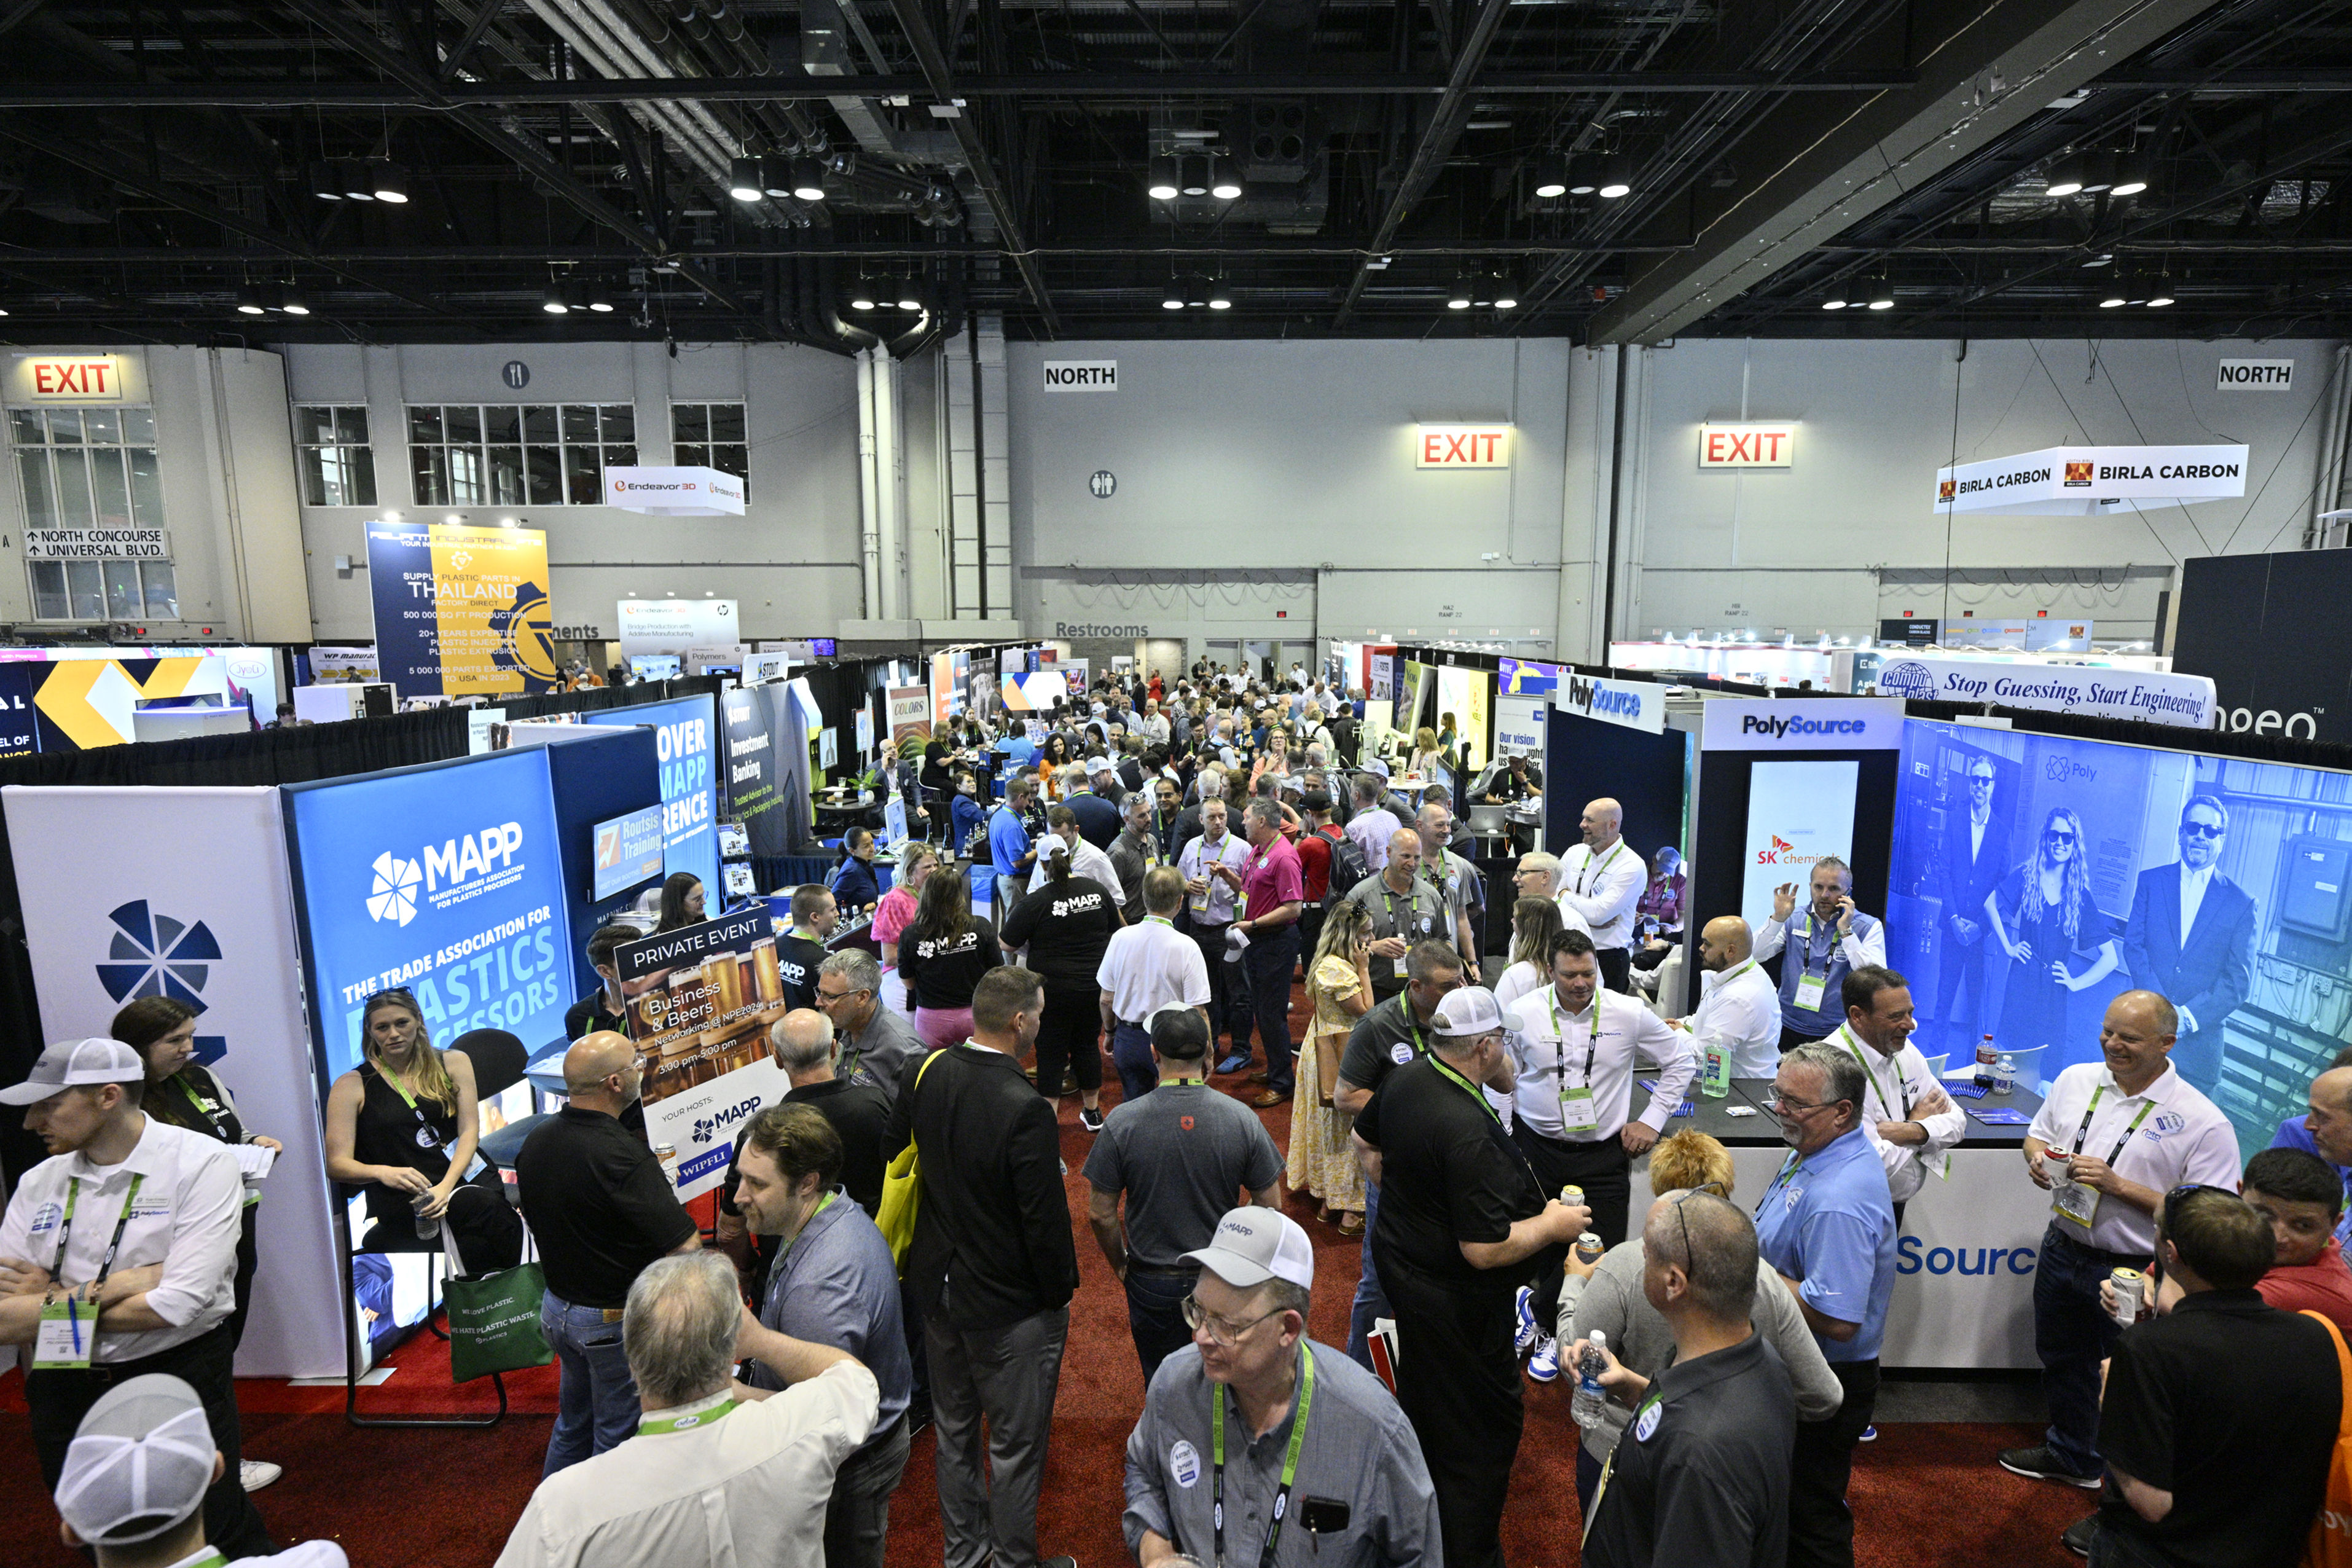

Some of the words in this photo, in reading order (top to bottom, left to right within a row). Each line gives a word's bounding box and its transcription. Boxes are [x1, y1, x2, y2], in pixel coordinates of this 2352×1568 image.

[35, 364, 109, 393] EXIT
[1046, 367, 1115, 384] NORTH
[2220, 366, 2291, 383] NORTH
[1424, 434, 1502, 462] EXIT
[1707, 433, 1786, 461] EXIT
[1959, 477, 1993, 493] BIRLA
[1997, 468, 2050, 487] CARBON
[2100, 466, 2153, 479] BIRLA
[2160, 465, 2238, 479] CARBON
[715, 486, 735, 498] Endeavor
[41, 530, 83, 542] NORTH
[88, 530, 161, 542] CONCOURSE
[436, 535, 511, 544] INDUSTRIAL
[47, 545, 120, 556] UNIVERSAL
[127, 545, 163, 556] BLVD.
[407, 582, 517, 598] THAILAND
[1056, 622, 1148, 637] Restrooms
[763, 662, 778, 676] STOUT
[1406, 668, 1417, 683] You
[1881, 671, 1929, 688] compu
[1569, 676, 1641, 717] PolySource
[1944, 673, 1988, 697] Stop
[1994, 678, 2082, 705] Guessing,
[2087, 683, 2128, 705] Start
[2130, 686, 2206, 723] Engineering!
[733, 706, 750, 723] STOUT
[895, 700, 924, 716] COLORS
[1743, 715, 1866, 739] PolySource
[14, 735, 29, 745] OF
[731, 732, 769, 758] Investment
[1500, 732, 1511, 743] Our
[1514, 733, 1535, 746] vision
[732, 759, 761, 783] Banking
[1499, 757, 1507, 767] us
[2072, 762, 2097, 782] Poly
[734, 791, 748, 807] Trusted
[749, 789, 762, 801] Advisor
[753, 800, 770, 815] Packaging
[623, 812, 659, 839] Routsis
[423, 821, 523, 892] MAPP
[623, 834, 661, 860] Training
[1757, 851, 1778, 864] SK
[429, 878, 484, 903] MANUFACTURERS
[486, 864, 525, 884] ASSOCIATION
[599, 881, 610, 891] VISIT
[611, 877, 621, 886] OUR
[622, 869, 640, 882] BOOTHS:
[437, 899, 451, 909] FOR
[453, 889, 482, 904] PLASTICS
[484, 873, 522, 893] PROCESSORS
[1068, 893, 1102, 909] MAPP
[633, 935, 705, 968] PRIVATE
[708, 919, 758, 946] EVENT
[936, 932, 977, 951] MPP
[342, 977, 377, 1005] THE
[380, 954, 433, 989] TRADE
[436, 916, 525, 968] ASSOCIATION
[528, 905, 551, 927] FOR
[649, 982, 721, 1015] Business
[652, 1017, 664, 1032] &
[667, 1002, 713, 1027] Beers
[655, 1021, 710, 1046] Networking
[711, 1016, 721, 1027] @
[723, 1002, 762, 1021] NPE2024
[659, 1060, 680, 1075] 3:00
[682, 1045, 719, 1067] pm-5:00
[722, 1038, 737, 1051] pm
[662, 1108, 685, 1123] YOUR
[686, 1096, 714, 1113] HOSTS:
[715, 1096, 761, 1128] MAPP
[717, 1119, 743, 1133] MANUFACTURERS
[2145, 1130, 2162, 1140] pta
[682, 1151, 726, 1178] WIPFLI
[1227, 1223, 1253, 1236] MAPP
[1896, 1236, 2036, 1276] Sourc
[471, 1306, 485, 1315] LOVE
[487, 1298, 514, 1311] PLASTIC.
[477, 1319, 508, 1333] PLASTIC
[509, 1311, 535, 1324] WASTE.
[483, 1332, 508, 1343] PLASTICS
